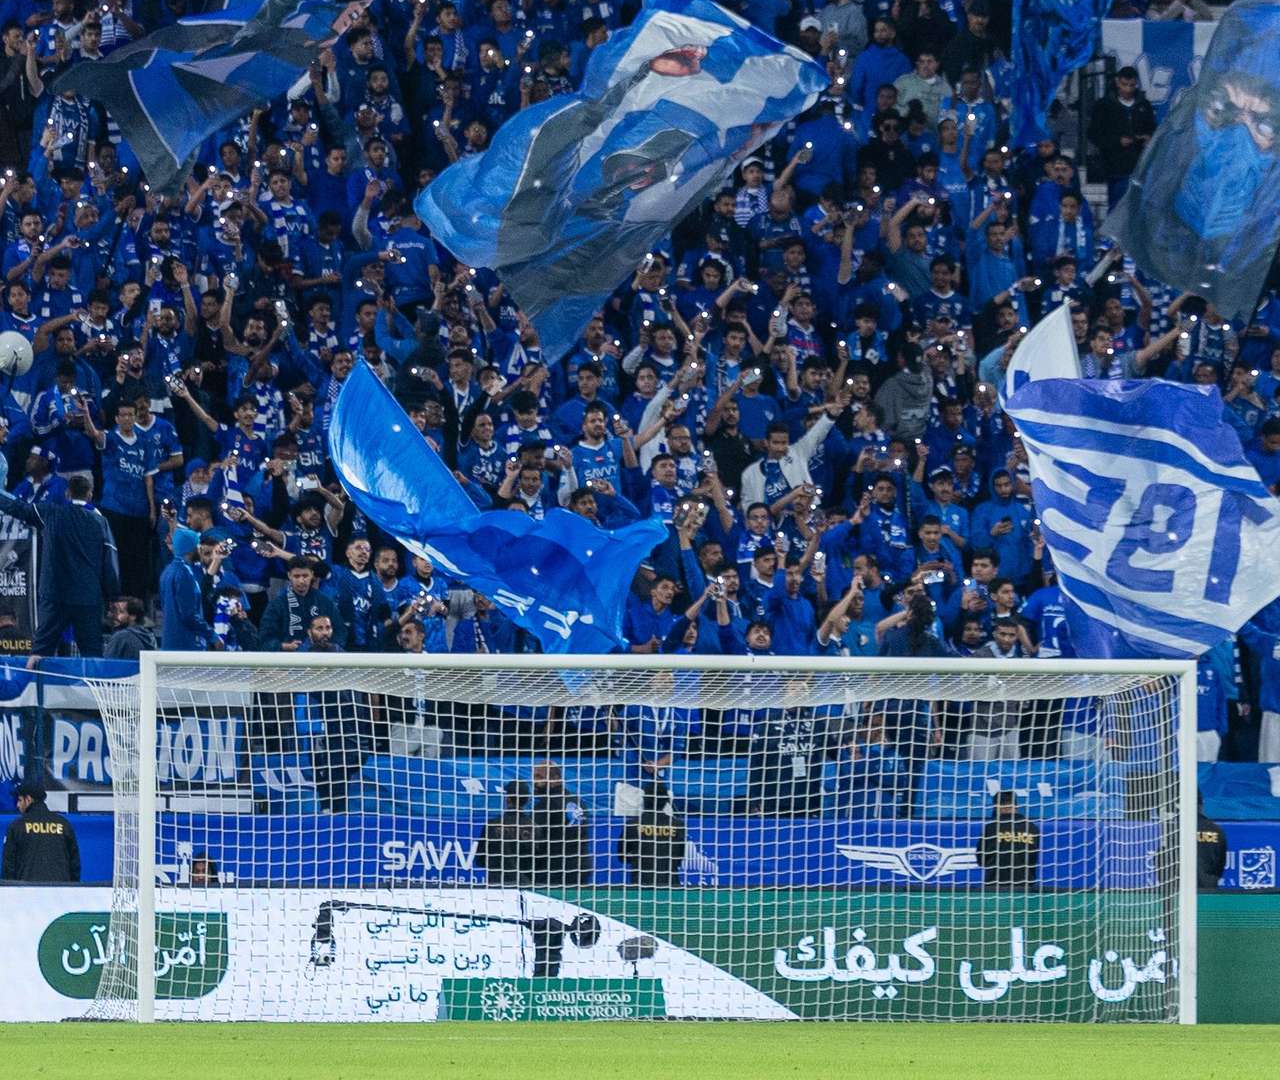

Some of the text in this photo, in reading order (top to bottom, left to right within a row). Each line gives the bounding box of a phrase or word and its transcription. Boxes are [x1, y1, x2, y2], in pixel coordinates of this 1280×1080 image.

[24, 822, 64, 835] POLICE
[637, 825, 677, 838] POLICE
[382, 840, 478, 871] SAVV
[424, 946, 446, 965] ما
[454, 951, 492, 971] وين
[774, 926, 938, 1000] كيفك
[960, 927, 1067, 1002] على
[367, 983, 429, 1012] ما تبي
[536, 1005, 634, 1018] ROSHN GROUP
